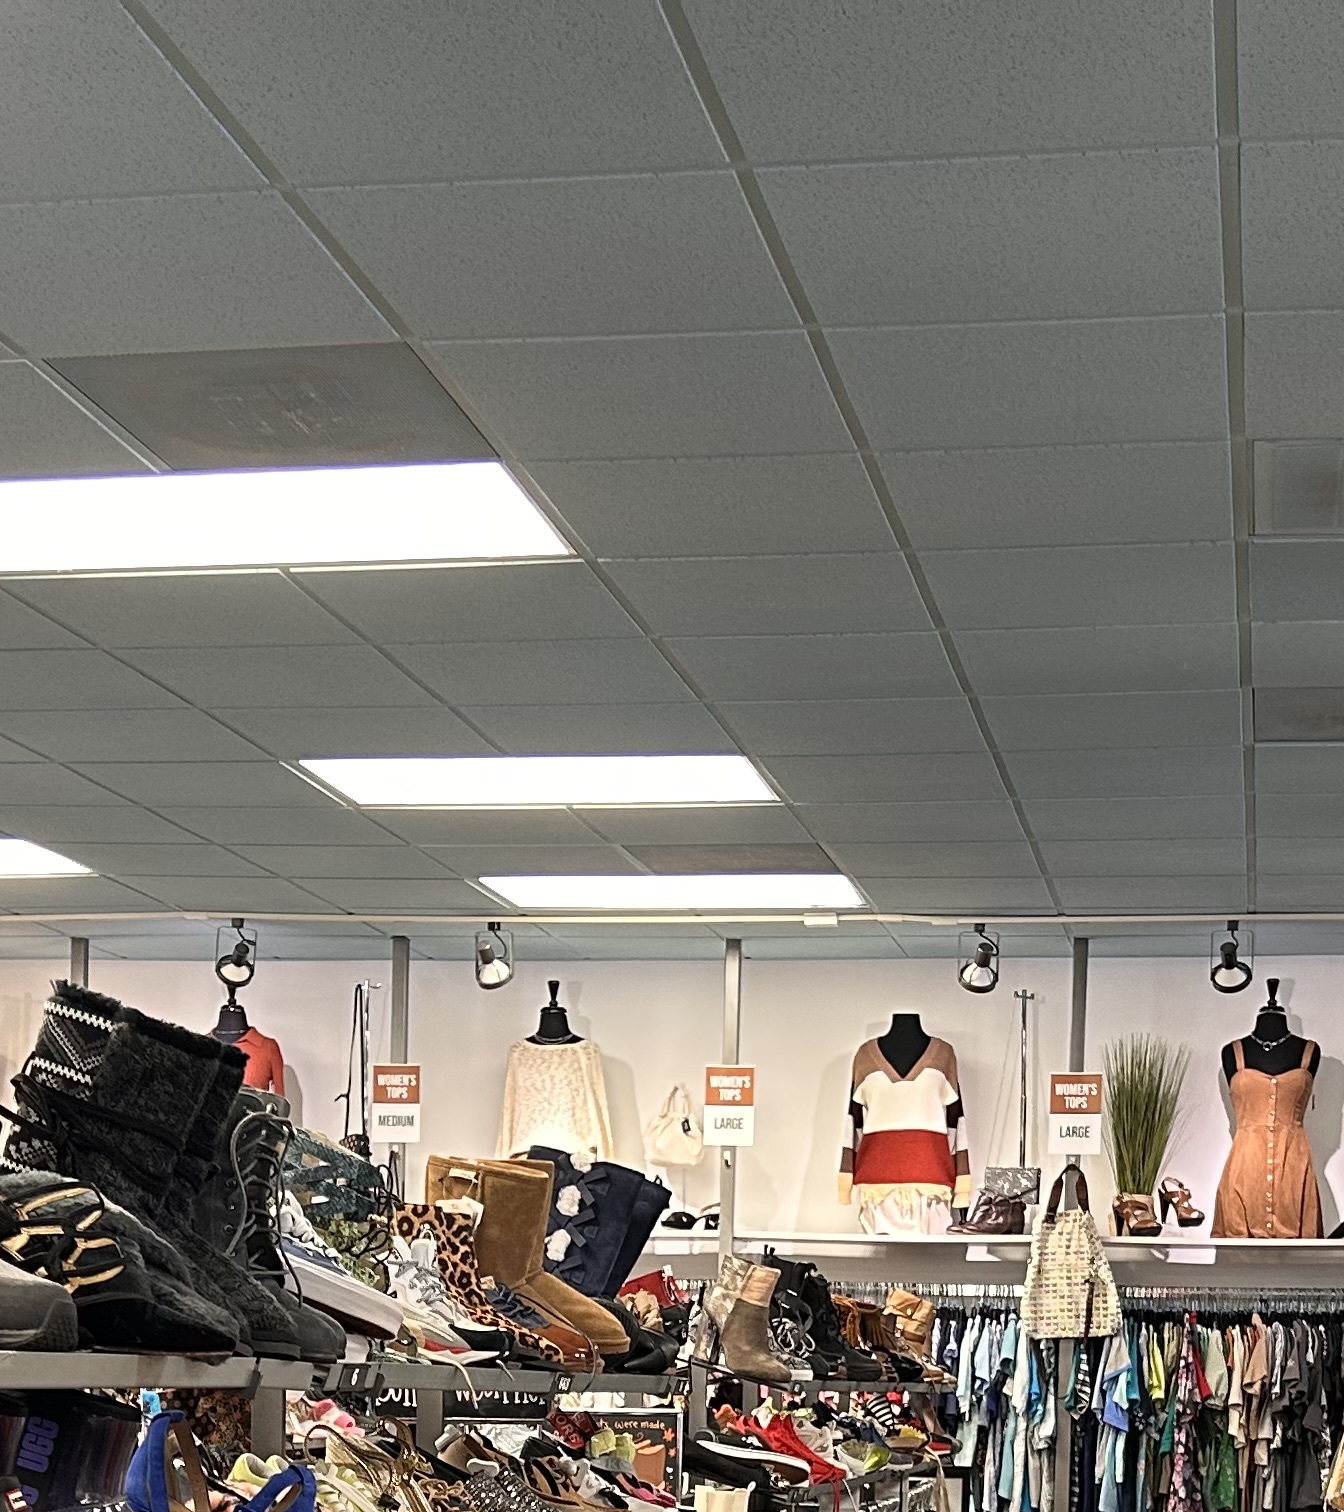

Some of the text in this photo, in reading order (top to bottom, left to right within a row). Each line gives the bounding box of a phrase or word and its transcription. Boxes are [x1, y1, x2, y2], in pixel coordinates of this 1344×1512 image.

[377, 1074, 417, 1087] WOMEN'S
[709, 1075, 751, 1089] WOMEN'S
[386, 1086, 408, 1099] TOPS
[718, 1088, 742, 1101] TOPS
[1054, 1083, 1098, 1096] WOMEN'S
[1064, 1096, 1088, 1109] TOPS
[378, 1114, 415, 1127] MEDIUM
[714, 1117, 744, 1130] LARGE
[1059, 1125, 1091, 1138] LARGE
[350, 1368, 360, 1388] 6
[16, 1416, 60, 1473] UGG
